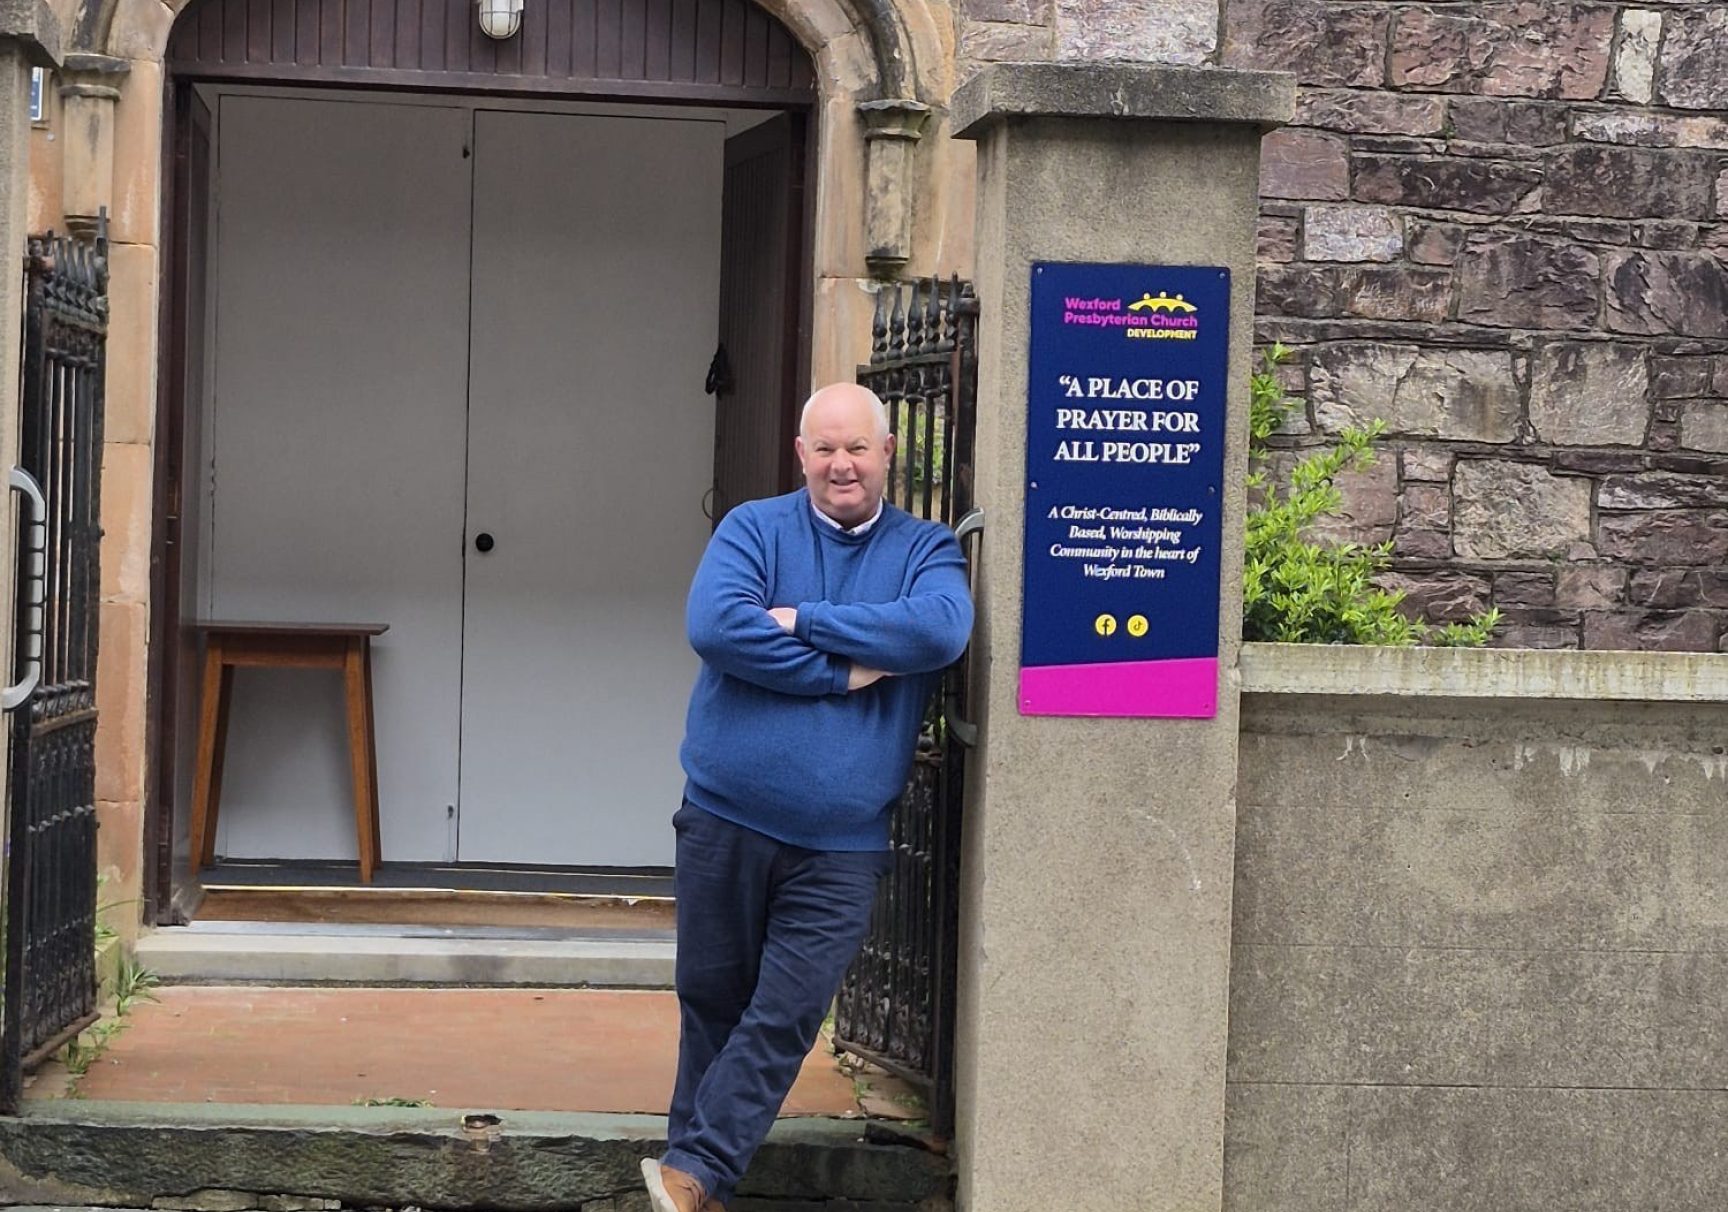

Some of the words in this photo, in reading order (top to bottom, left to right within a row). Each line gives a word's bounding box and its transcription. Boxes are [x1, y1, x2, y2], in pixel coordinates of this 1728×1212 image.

[1064, 298, 1121, 311] Wexford
[1064, 312, 1148, 327] Presbyterian
[1150, 314, 1198, 327] Church
[1127, 328, 1198, 339] DEVELOPMENT
[1059, 375, 1084, 398] “A
[1087, 378, 1163, 399] PLACE
[1166, 380, 1199, 400] OF
[1056, 409, 1148, 431] PRAYER
[1152, 412, 1200, 432] FOR
[1053, 441, 1099, 461] ALL
[1101, 442, 1201, 464] PEOPLE”
[1048, 506, 1059, 519] A
[1061, 505, 1148, 522] Christ-Centred,
[1150, 508, 1203, 526] Biblically
[1069, 526, 1107, 540] Based,
[1110, 527, 1182, 544] Worshipping
[1050, 544, 1120, 561] Community
[1121, 546, 1133, 559] in
[1135, 546, 1153, 559] the
[1154, 546, 1185, 560] heart
[1187, 547, 1200, 563] of
[1083, 564, 1131, 580] Wexford
[1133, 565, 1165, 579] Town
